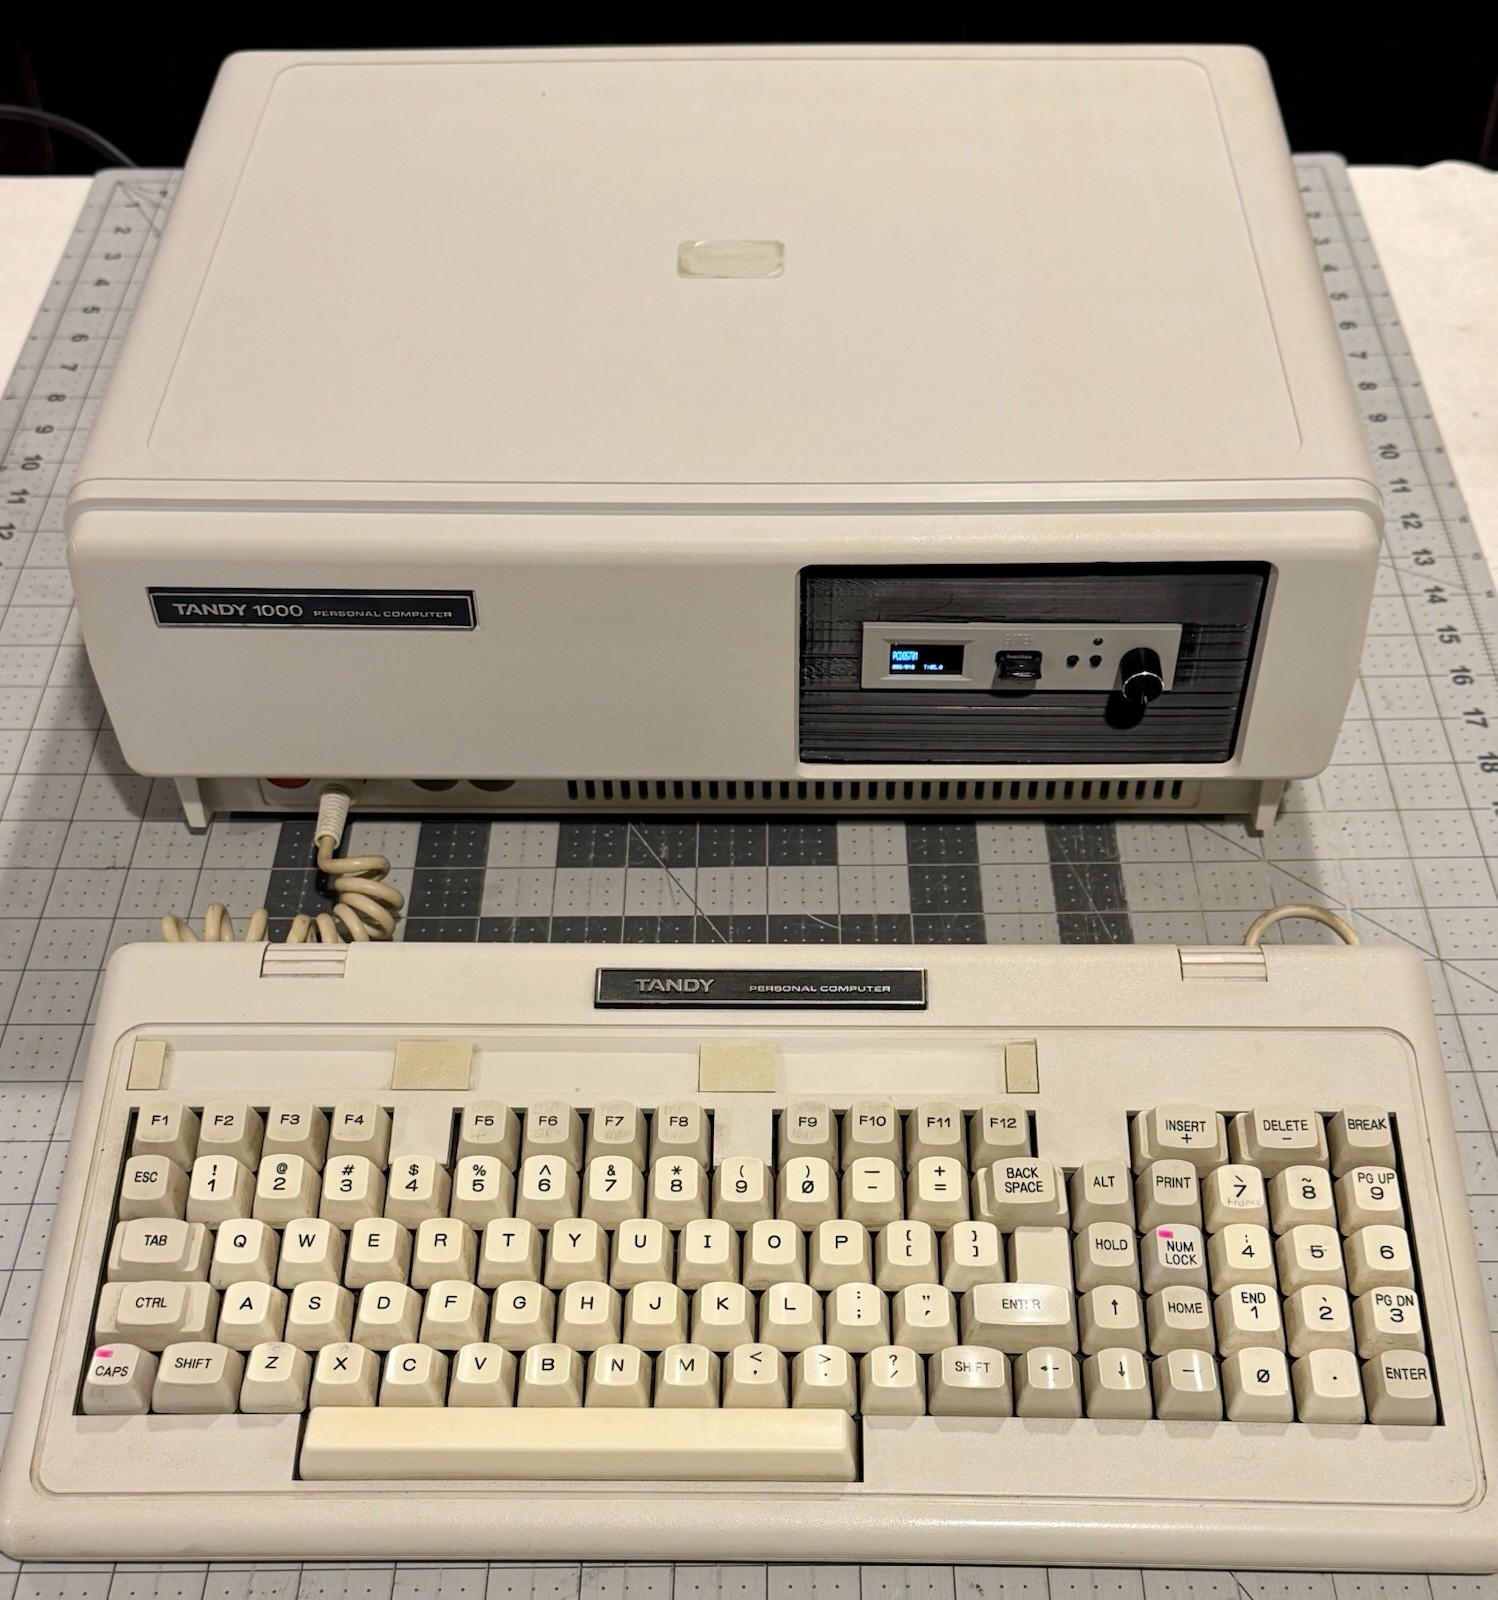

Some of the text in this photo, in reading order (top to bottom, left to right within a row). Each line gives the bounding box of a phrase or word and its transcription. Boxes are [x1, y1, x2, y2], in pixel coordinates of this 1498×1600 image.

[114, 226, 132, 236] 2
[104, 251, 122, 262] 3
[1322, 263, 1339, 273] 4
[93, 278, 112, 288] 4
[1330, 291, 1348, 302] 5
[82, 305, 101, 316] 5
[1338, 320, 1357, 331] 6
[71, 333, 90, 344] 6
[1347, 350, 1368, 360] 7
[60, 362, 79, 373] 7
[1358, 380, 1378, 392] 8
[48, 393, 67, 404] 8
[1368, 412, 1388, 423] 9
[35, 424, 55, 435] 9
[1377, 442, 1401, 461] 10
[21, 454, 43, 471] 10
[1389, 477, 1412, 493] 11
[7, 488, 30, 504] 11
[1400, 511, 1424, 531] 12
[0, 523, 17, 541] 12
[1411, 547, 1436, 568] 13
[1423, 585, 1449, 605] 14
[170, 601, 453, 619] TANDY 1000 PERSONAL COMPUTER
[1436, 624, 1462, 646] 15
[1449, 665, 1475, 686] 16
[1462, 706, 1490, 729] 17
[1477, 751, 1498, 774] 18
[633, 977, 893, 994] TANDY PERSONAL COMPUTER
[151, 1114, 169, 1126] F1
[214, 1114, 234, 1126] F2
[280, 1113, 300, 1125] F3
[344, 1114, 364, 1125] F4
[474, 1115, 494, 1127] F5
[538, 1115, 558, 1127] F6
[605, 1115, 625, 1127] F7
[669, 1116, 689, 1127] F8
[798, 1116, 818, 1128] F9
[859, 1115, 887, 1127] F10
[927, 1116, 951, 1128] F11
[990, 1117, 1017, 1129] F12
[1165, 1119, 1206, 1132] INSERT
[1263, 1119, 1309, 1132] DELETE
[1347, 1118, 1387, 1131] BREAK
[212, 1164, 218, 1176] !
[276, 1162, 288, 1175] @
[341, 1164, 355, 1176] #
[408, 1163, 419, 1177] $
[472, 1164, 487, 1177] %
[539, 1164, 552, 1176] ^
[606, 1164, 616, 1177] &
[739, 1164, 744, 1178] (
[805, 1165, 811, 1179] )
[934, 1165, 946, 1177] +
[1006, 1166, 1039, 1179] BACK
[134, 1171, 158, 1183] ESC
[272, 1177, 286, 1191] 2
[1093, 1175, 1115, 1188] ALT
[1156, 1175, 1191, 1189] PRINT
[1357, 1171, 1395, 1185] PG UP
[207, 1178, 216, 1192] 1
[339, 1178, 353, 1193] 3
[405, 1178, 419, 1192] 4
[472, 1179, 485, 1193] 5
[538, 1178, 551, 1192] 6
[604, 1179, 618, 1192] 7
[670, 1179, 683, 1193] 8
[735, 1179, 748, 1194] 9
[934, 1183, 947, 1191] =
[1004, 1180, 1044, 1194] SPACE
[1233, 1184, 1247, 1198] 7
[1302, 1185, 1317, 1200] 8
[1370, 1186, 1384, 1201] 9
[144, 1234, 168, 1246] TAB
[233, 1234, 247, 1248] Q
[298, 1233, 316, 1248] W
[367, 1233, 380, 1248] E
[434, 1233, 448, 1247] R
[502, 1233, 516, 1247] T
[568, 1233, 582, 1248] Y
[634, 1234, 647, 1249] U
[703, 1234, 712, 1249] I
[767, 1234, 782, 1249] O
[835, 1235, 849, 1249] P
[1095, 1238, 1128, 1251] HOLD
[1166, 1240, 1194, 1253] NUM
[1241, 1244, 1255, 1258] 4
[1309, 1244, 1325, 1260] 5
[1379, 1245, 1395, 1260] 6
[1165, 1253, 1198, 1266] LOCK
[135, 1296, 168, 1309] CTRL
[239, 1296, 253, 1310] A
[308, 1296, 322, 1310] S
[377, 1296, 391, 1310] D
[444, 1295, 458, 1308] F
[512, 1295, 527, 1310] G
[580, 1296, 594, 1310] H
[649, 1296, 662, 1310] J
[716, 1296, 729, 1311] K
[784, 1297, 797, 1311] L
[1240, 1291, 1266, 1304] END
[1375, 1293, 1415, 1307] PG DN
[1167, 1301, 1203, 1314] HOME
[1250, 1305, 1259, 1319] 1
[1318, 1305, 1334, 1321] 2
[1389, 1308, 1404, 1323] 3
[174, 1357, 213, 1369] SHIFT
[264, 1356, 279, 1369] Z
[474, 1357, 487, 1370] V
[749, 1351, 762, 1362] <
[820, 1354, 832, 1363] >
[889, 1354, 898, 1366] ?
[95, 1365, 129, 1377] CAPS
[333, 1357, 348, 1371] X
[402, 1358, 417, 1372] C
[541, 1358, 555, 1371] B
[611, 1358, 624, 1372] N
[679, 1358, 695, 1372] M
[1385, 1366, 1428, 1380] ENTER
